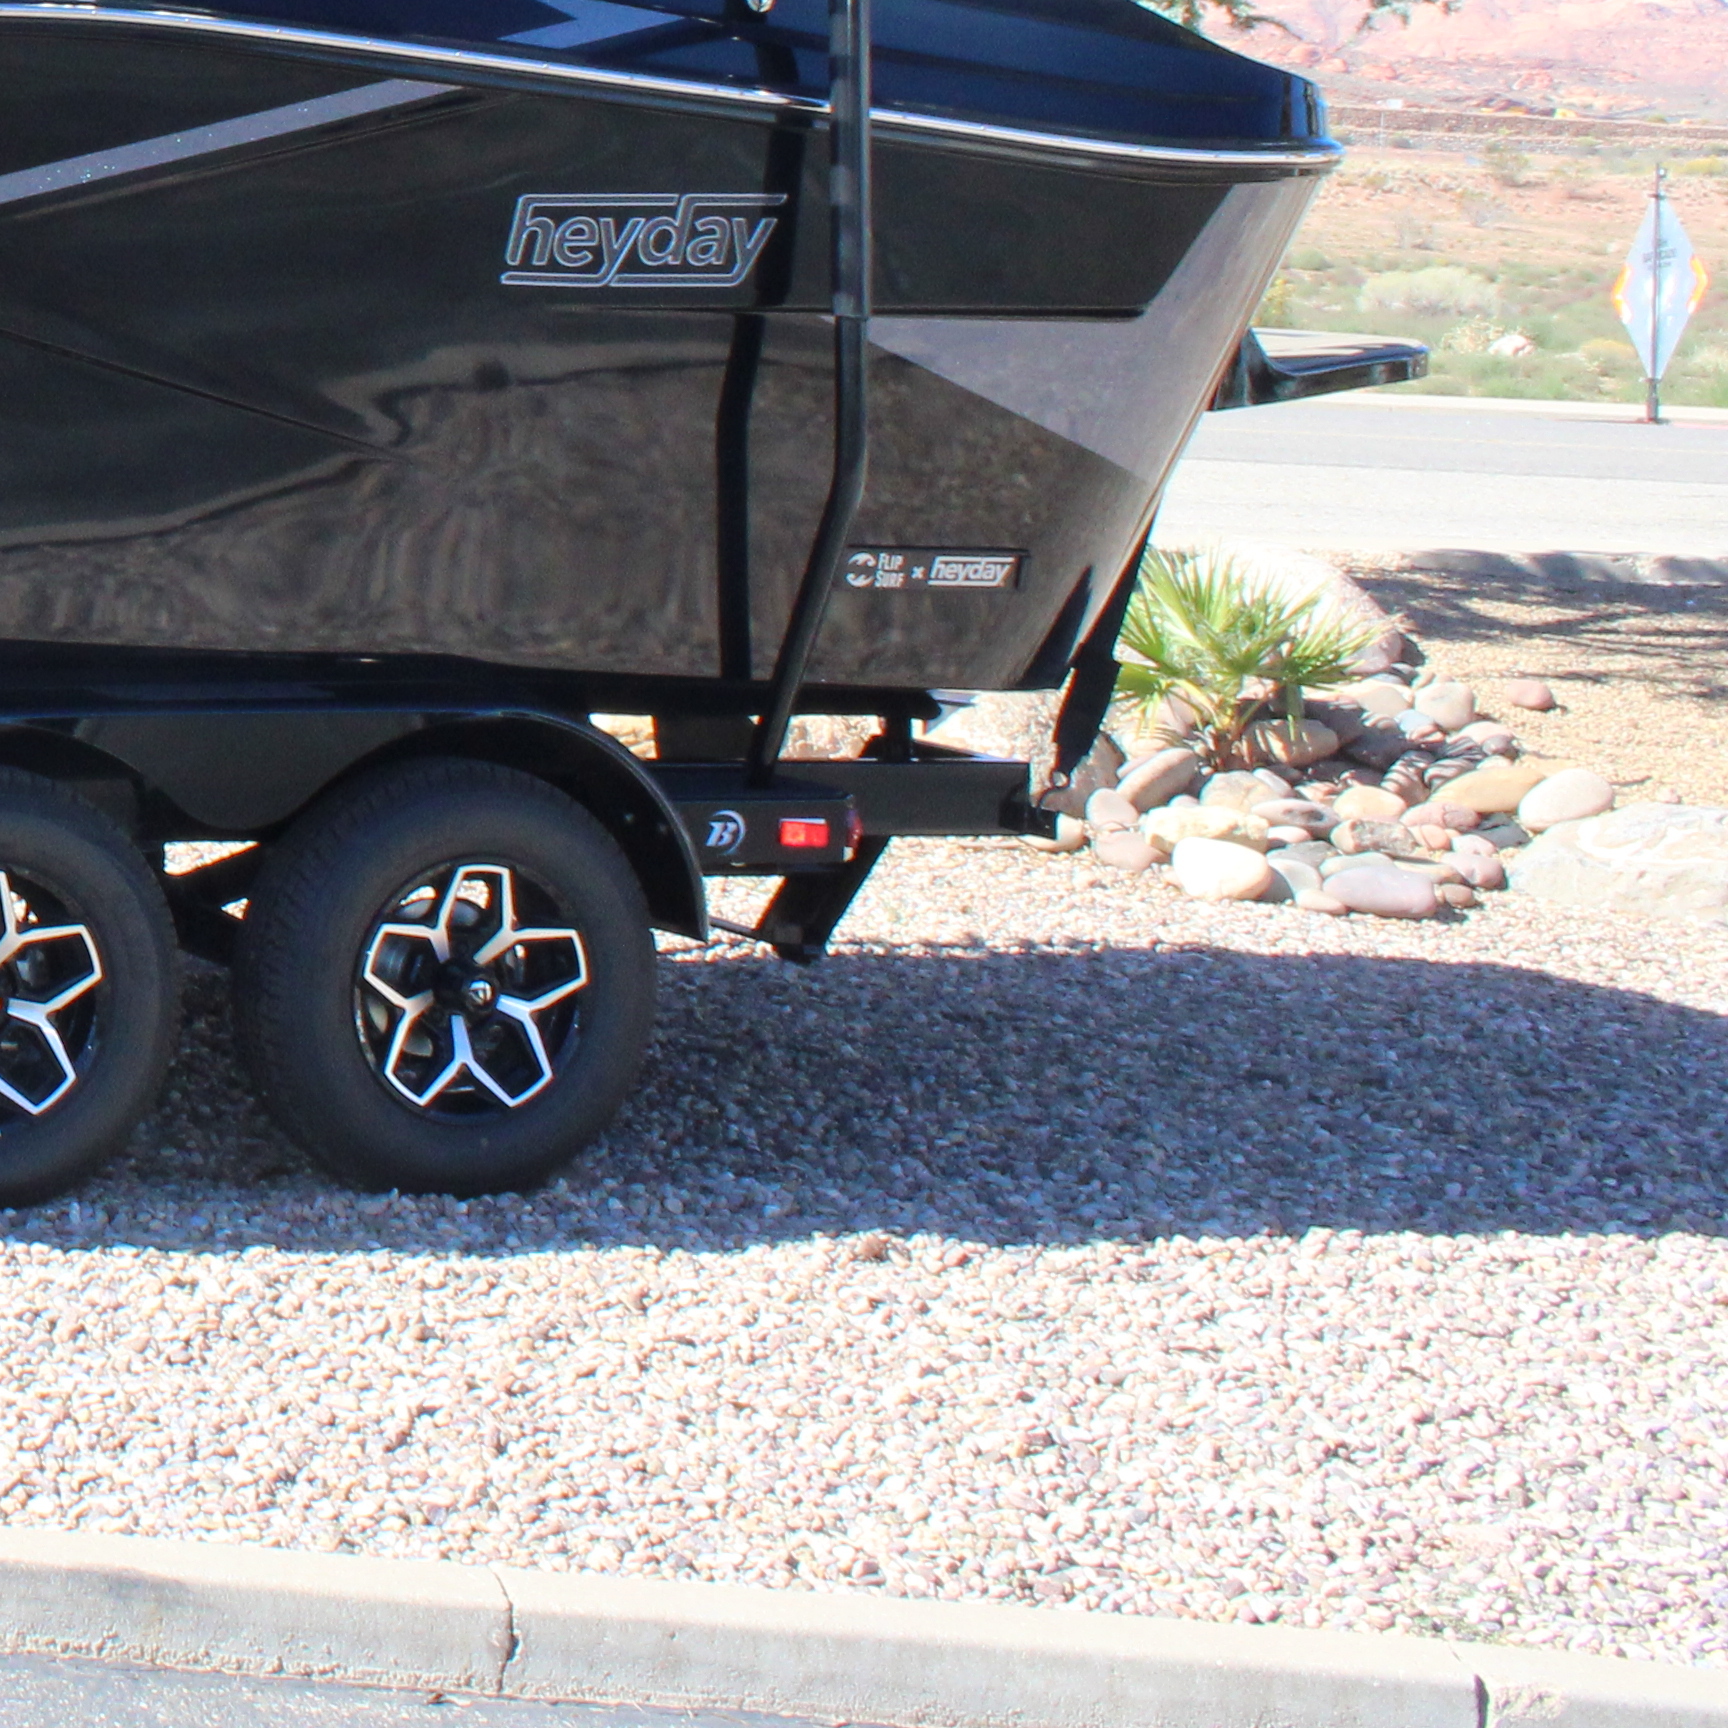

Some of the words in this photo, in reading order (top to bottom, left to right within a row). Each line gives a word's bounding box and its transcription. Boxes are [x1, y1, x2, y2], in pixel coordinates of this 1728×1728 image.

[500, 193, 788, 287] heyday
[878, 552, 905, 571] FLIP
[927, 556, 1016, 587] heyday
[874, 571, 905, 588] SURF
